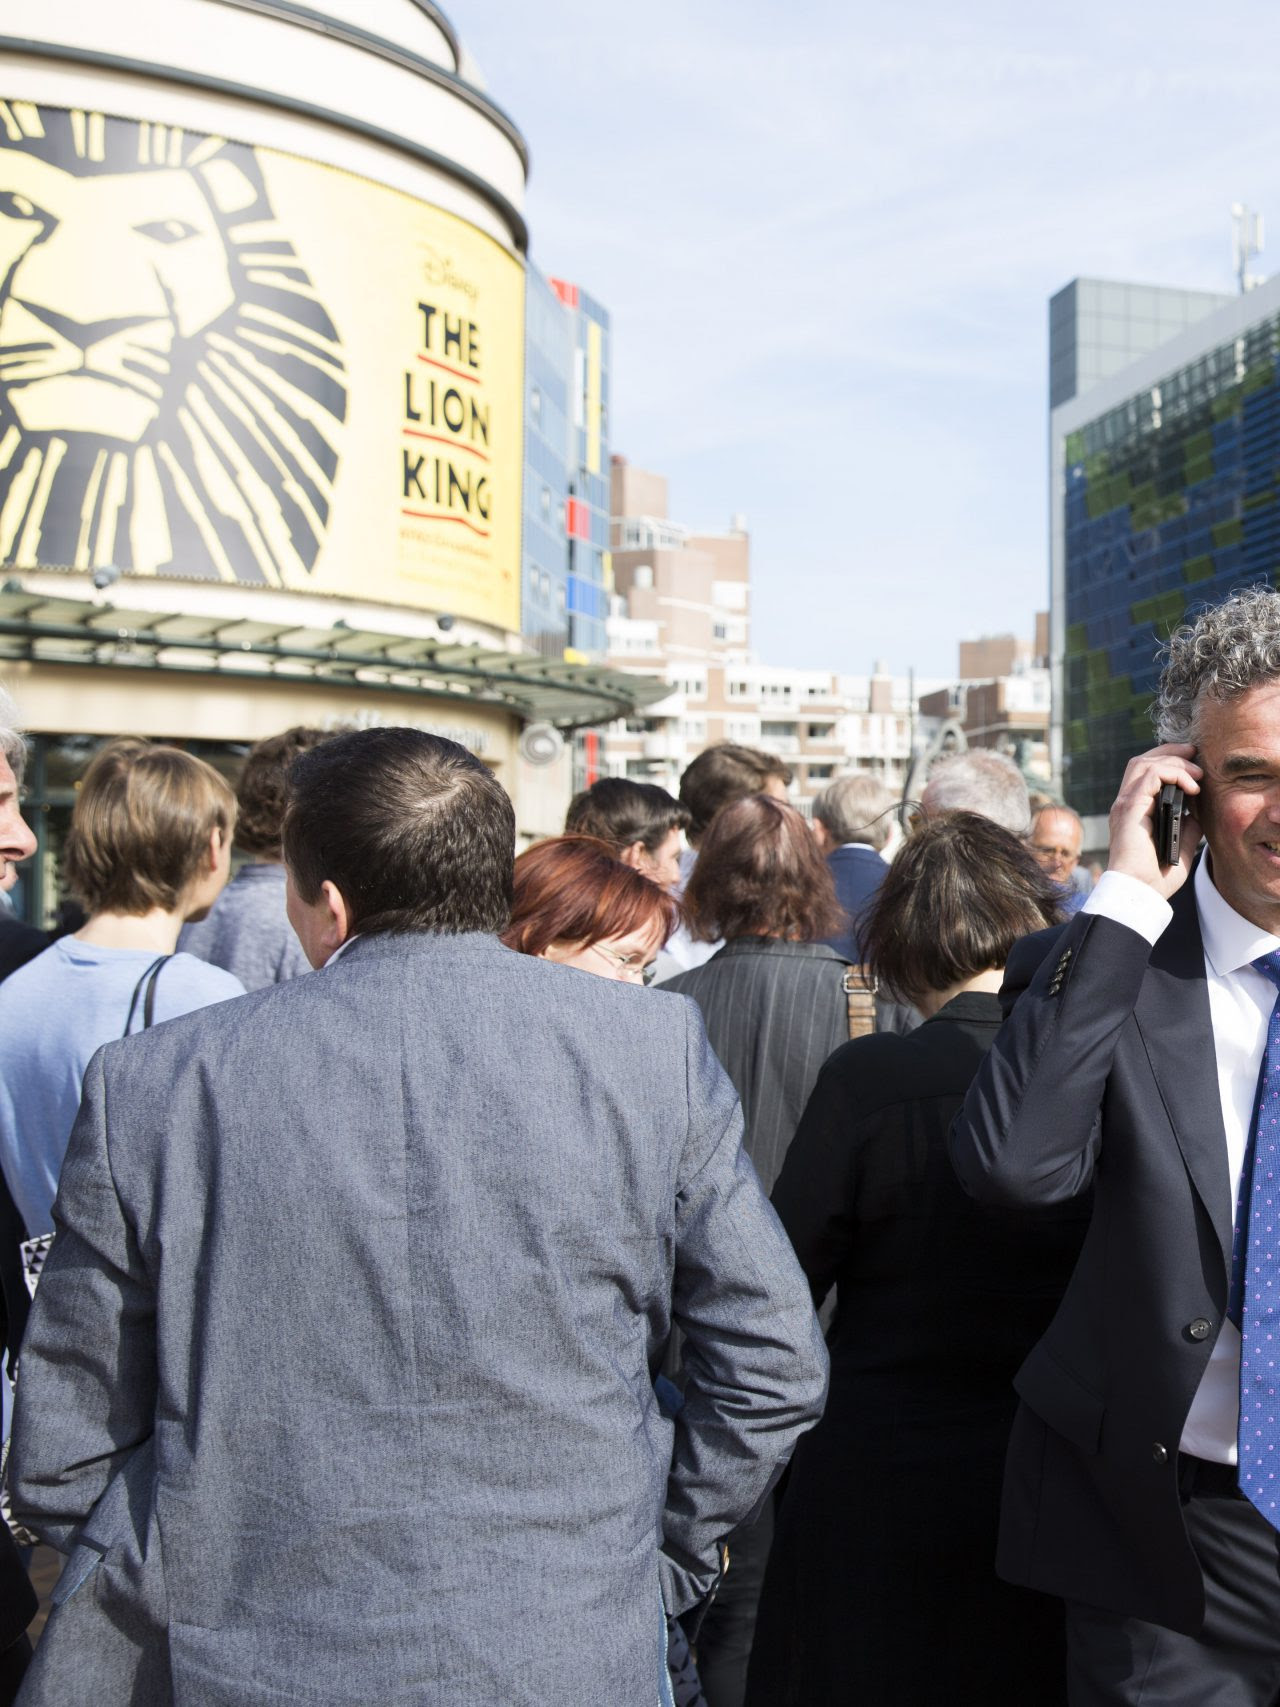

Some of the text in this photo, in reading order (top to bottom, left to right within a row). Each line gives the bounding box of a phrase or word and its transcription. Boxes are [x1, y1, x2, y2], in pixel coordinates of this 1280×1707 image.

[417, 301, 479, 369] THE
[404, 371, 489, 446] LION
[402, 448, 490, 520] KING
